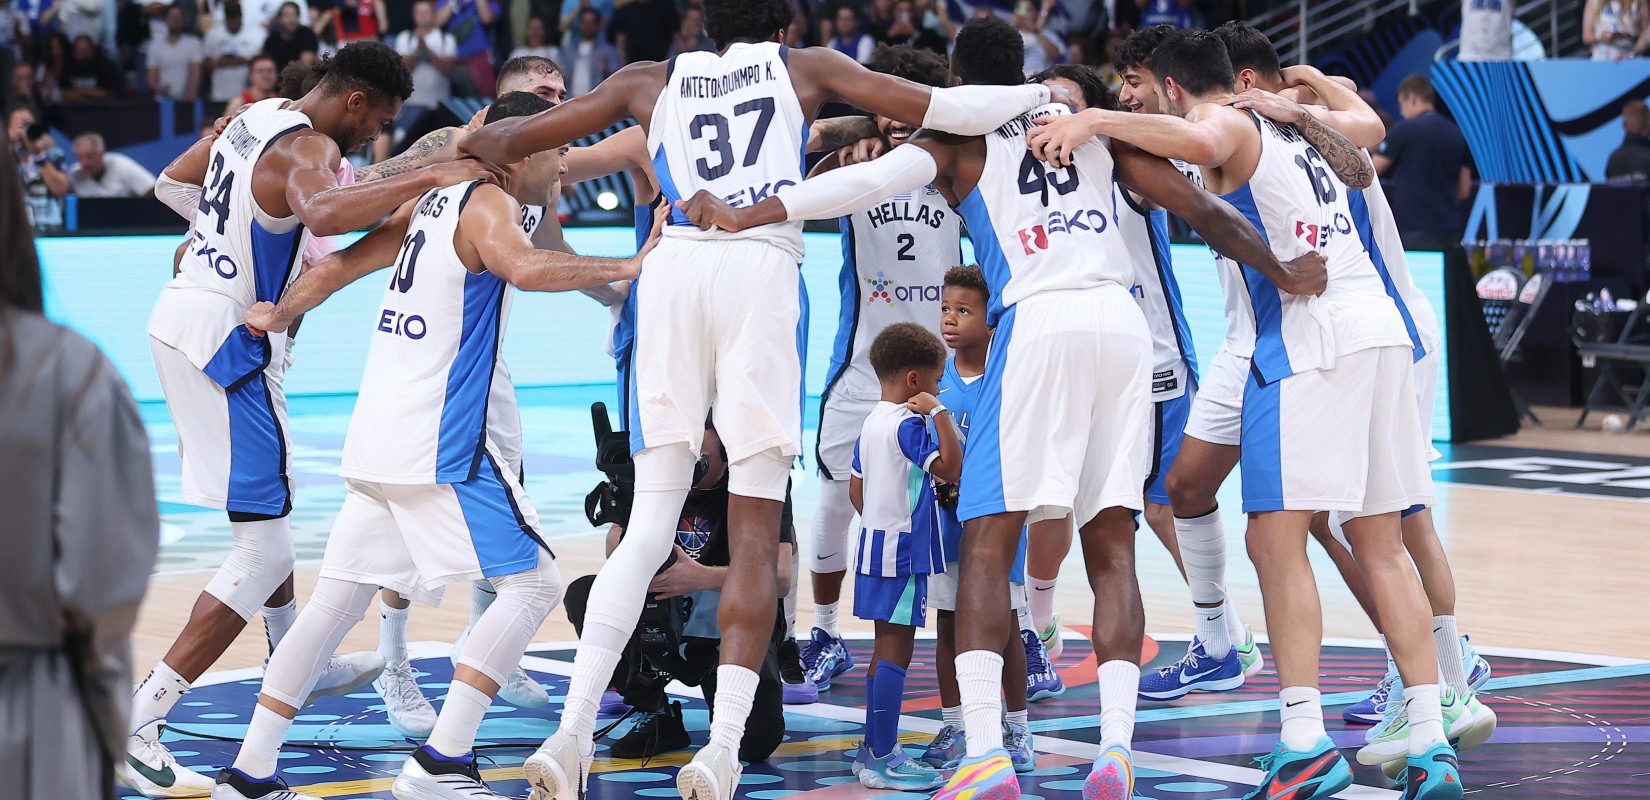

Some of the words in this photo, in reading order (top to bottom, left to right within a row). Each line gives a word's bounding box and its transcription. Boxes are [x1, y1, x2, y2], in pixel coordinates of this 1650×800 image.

[680, 64, 760, 98] ANTETOKOUNMPO
[765, 61, 777, 81] K.
[689, 96, 776, 182] 37
[199, 151, 235, 236] 24
[1294, 147, 1337, 207] 16
[867, 202, 945, 229] HELLAS
[1048, 209, 1108, 235] EKO
[896, 233, 916, 261] 2
